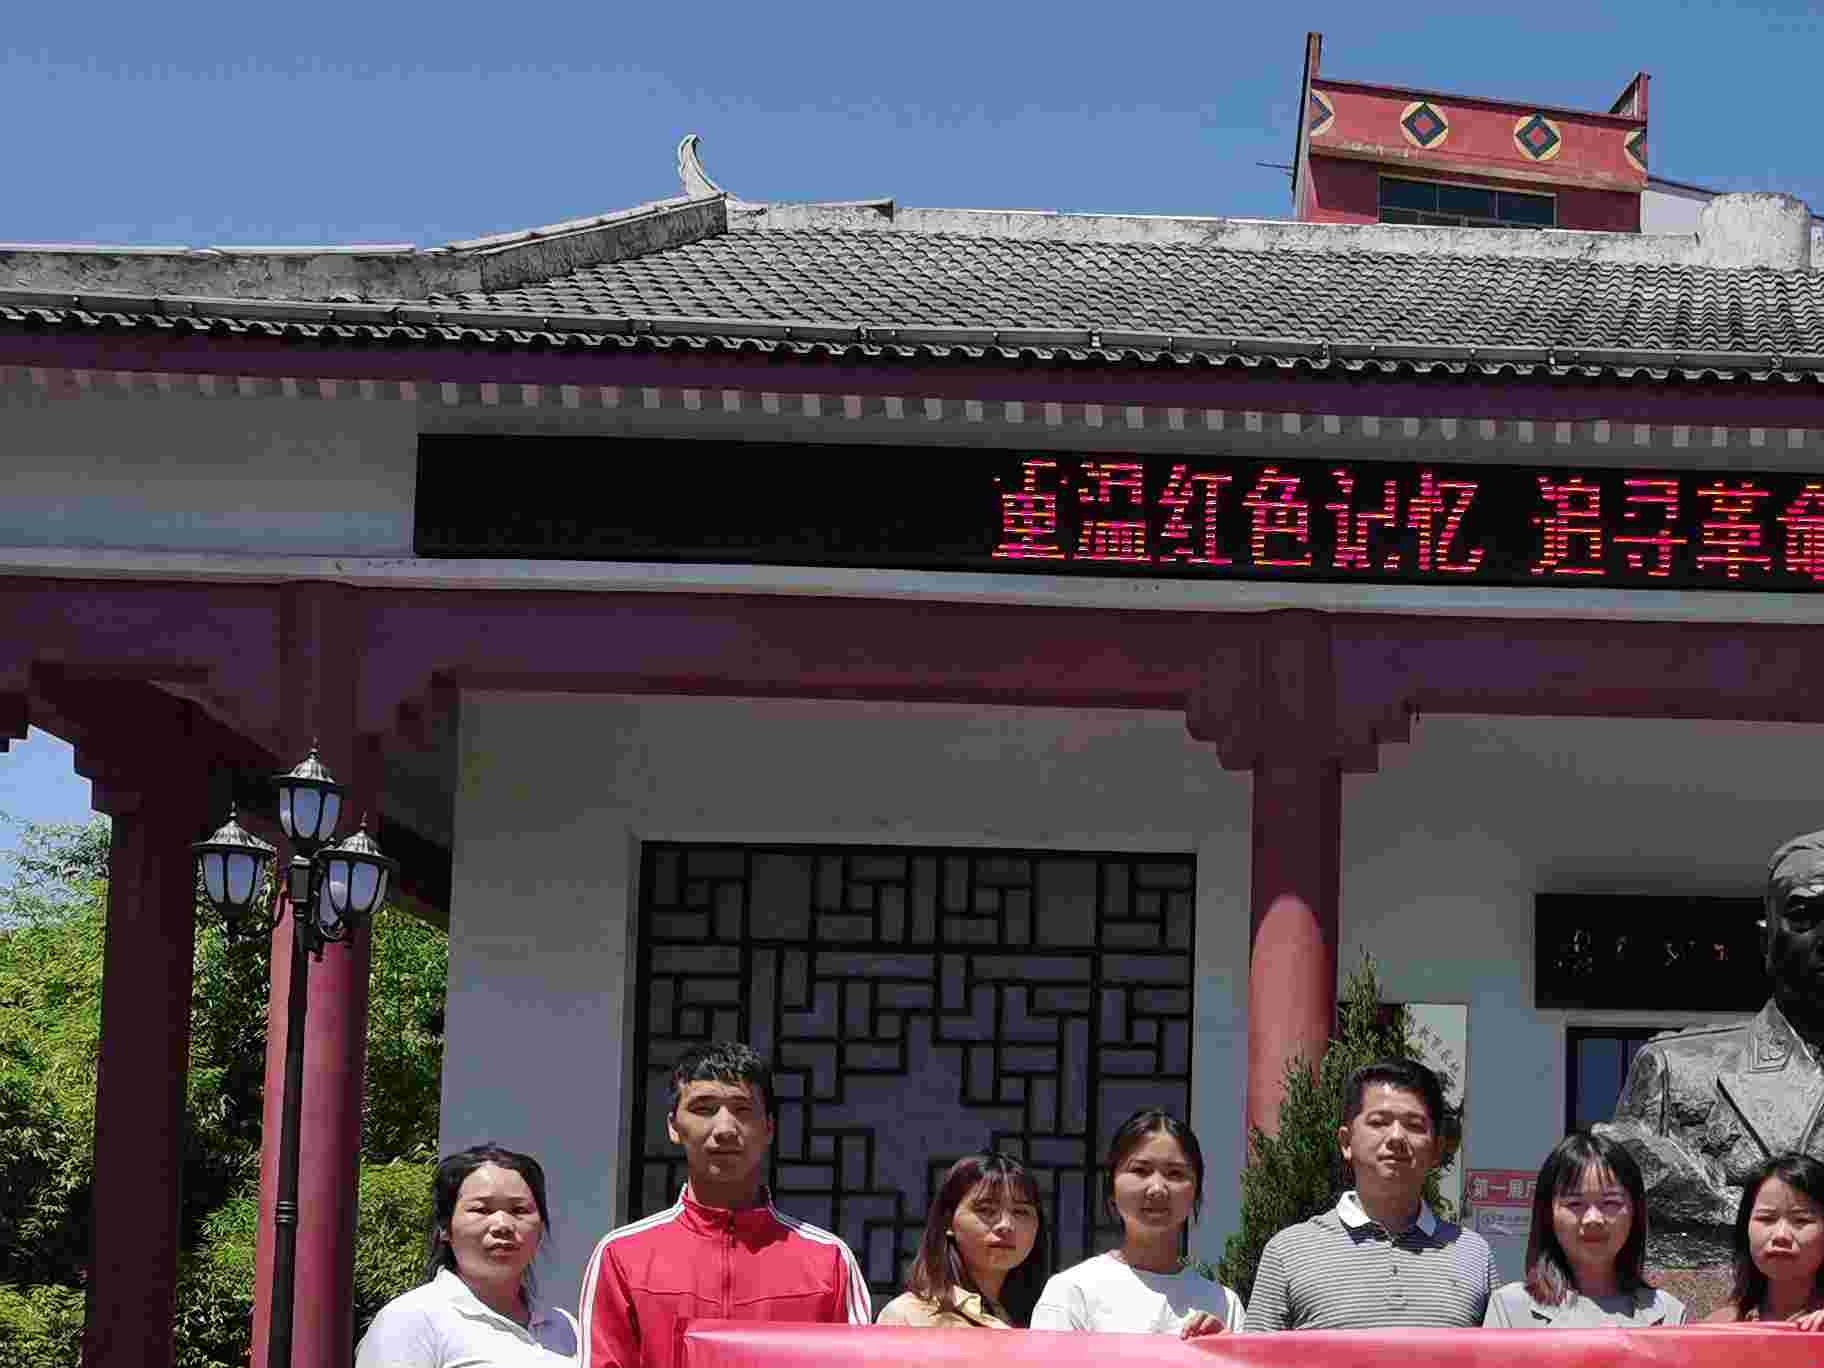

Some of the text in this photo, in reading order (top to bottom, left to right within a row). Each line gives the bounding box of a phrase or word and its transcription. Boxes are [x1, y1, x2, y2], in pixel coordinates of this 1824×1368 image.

[991, 460, 1486, 574] 重温红色记忆
